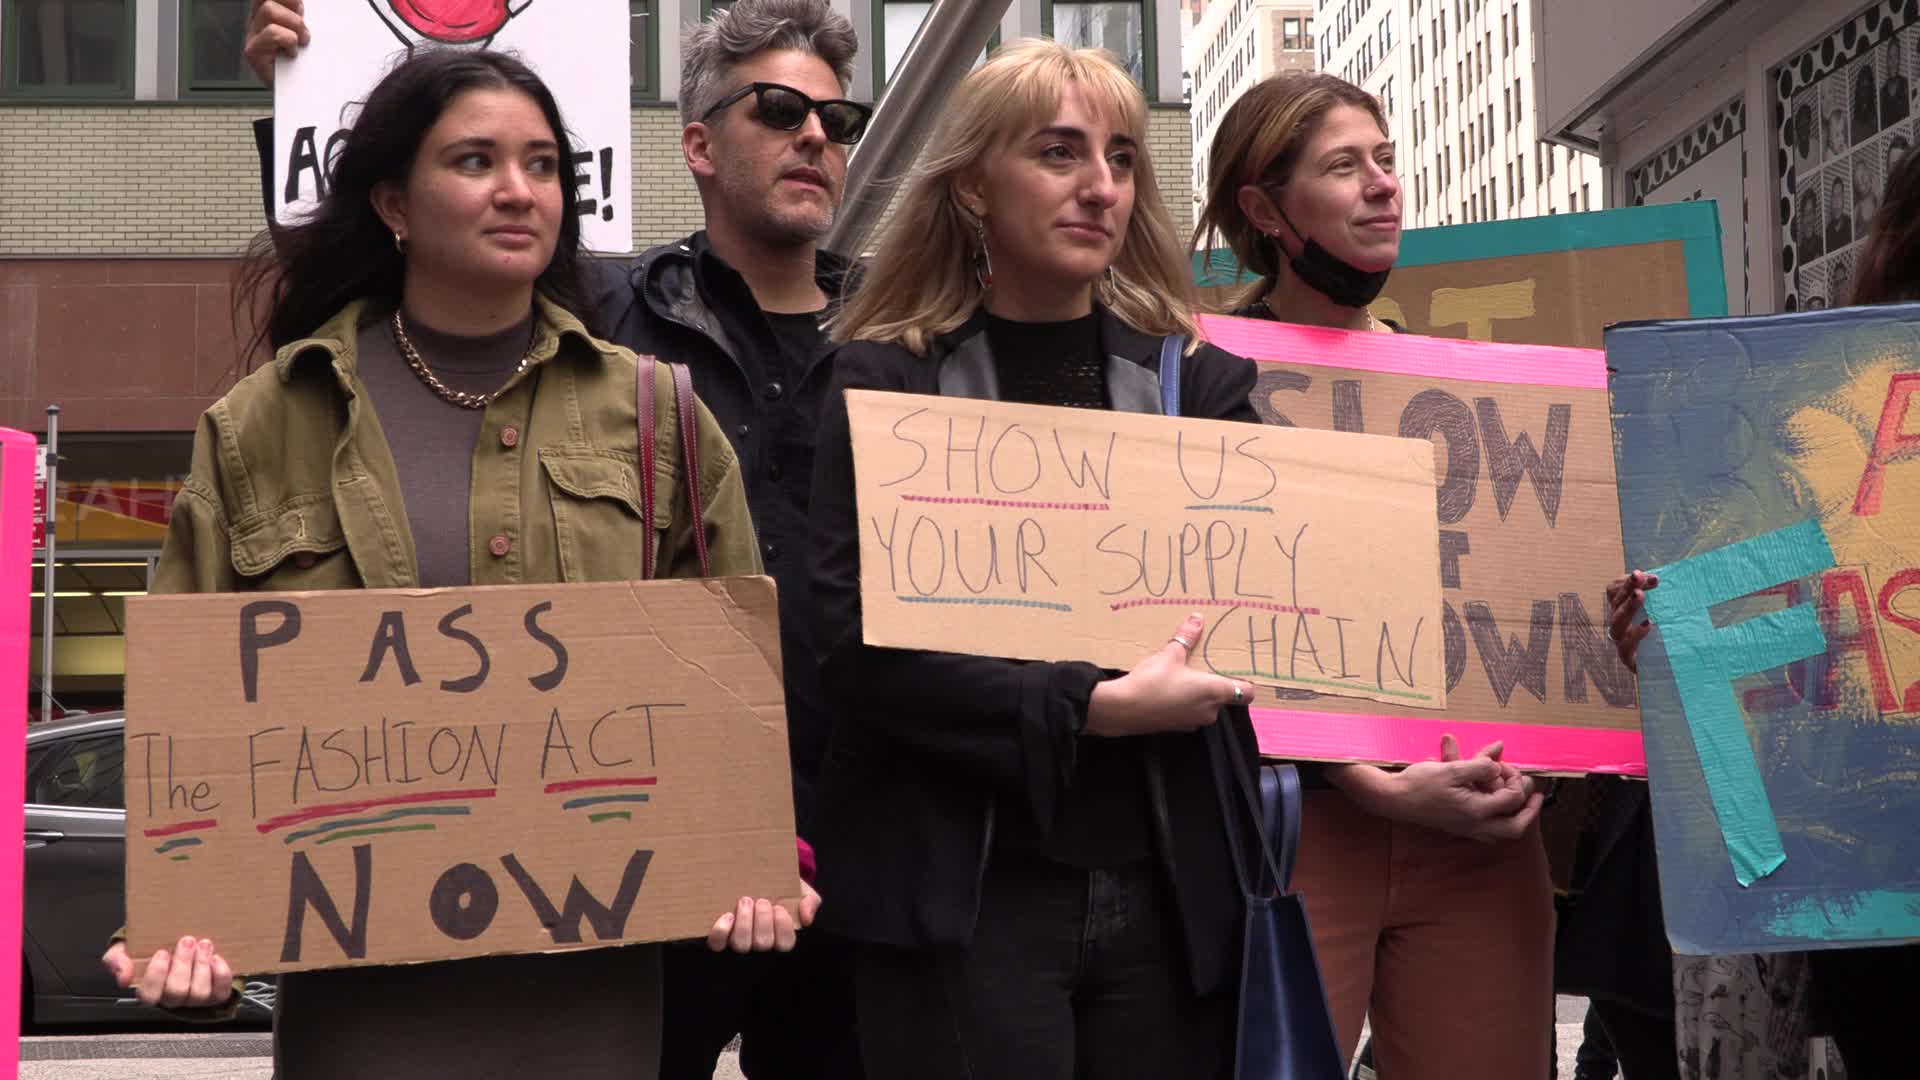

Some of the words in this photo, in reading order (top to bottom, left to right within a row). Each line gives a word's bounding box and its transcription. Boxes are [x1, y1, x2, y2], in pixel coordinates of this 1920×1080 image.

[879, 408, 1115, 500] SHOW
[1177, 430, 1277, 503] US
[871, 508, 1059, 597] YOUR
[1096, 519, 1309, 610] SUPPLY
[240, 600, 569, 703] PASS
[1203, 605, 1424, 690] CHAIN
[130, 732, 221, 818] The
[247, 716, 506, 818] FASHION
[541, 703, 686, 779] ACT
[279, 844, 655, 963] NOW
